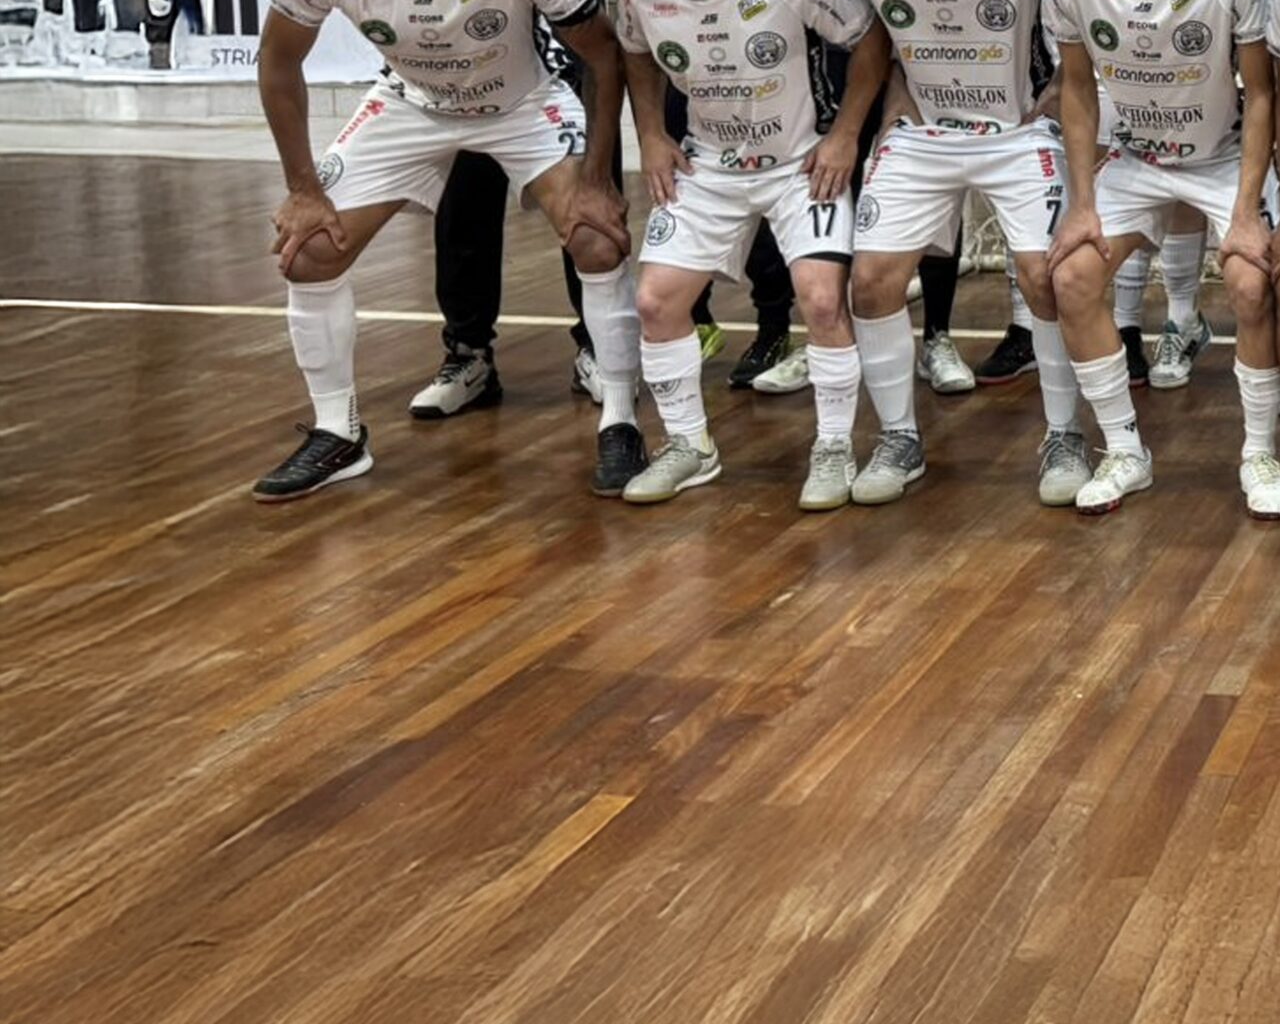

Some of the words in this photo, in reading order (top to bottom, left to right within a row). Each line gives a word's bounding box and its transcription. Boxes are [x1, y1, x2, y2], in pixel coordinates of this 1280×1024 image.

[914, 46, 977, 61] contorno
[401, 55, 471, 70] contorno
[1114, 66, 1176, 84] contorno
[690, 82, 752, 98] contorno
[808, 202, 838, 238] 17
